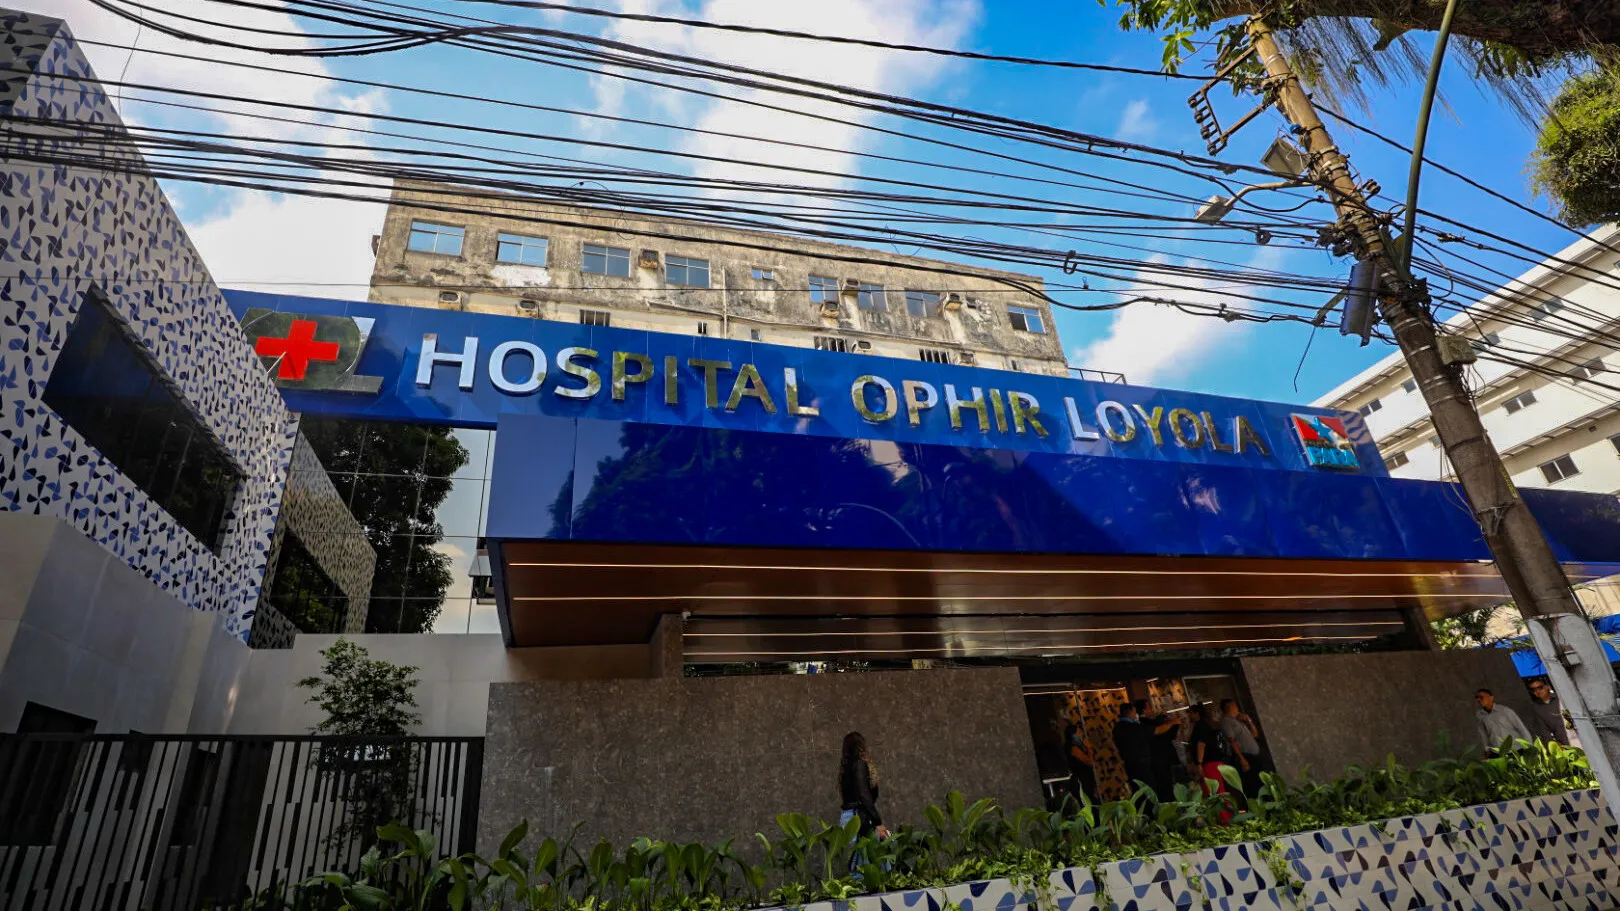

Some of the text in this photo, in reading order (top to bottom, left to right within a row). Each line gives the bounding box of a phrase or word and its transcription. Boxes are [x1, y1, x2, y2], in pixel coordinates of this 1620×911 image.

[415, 333, 1270, 455] HOSPITAL OPHIR LOYOLA
